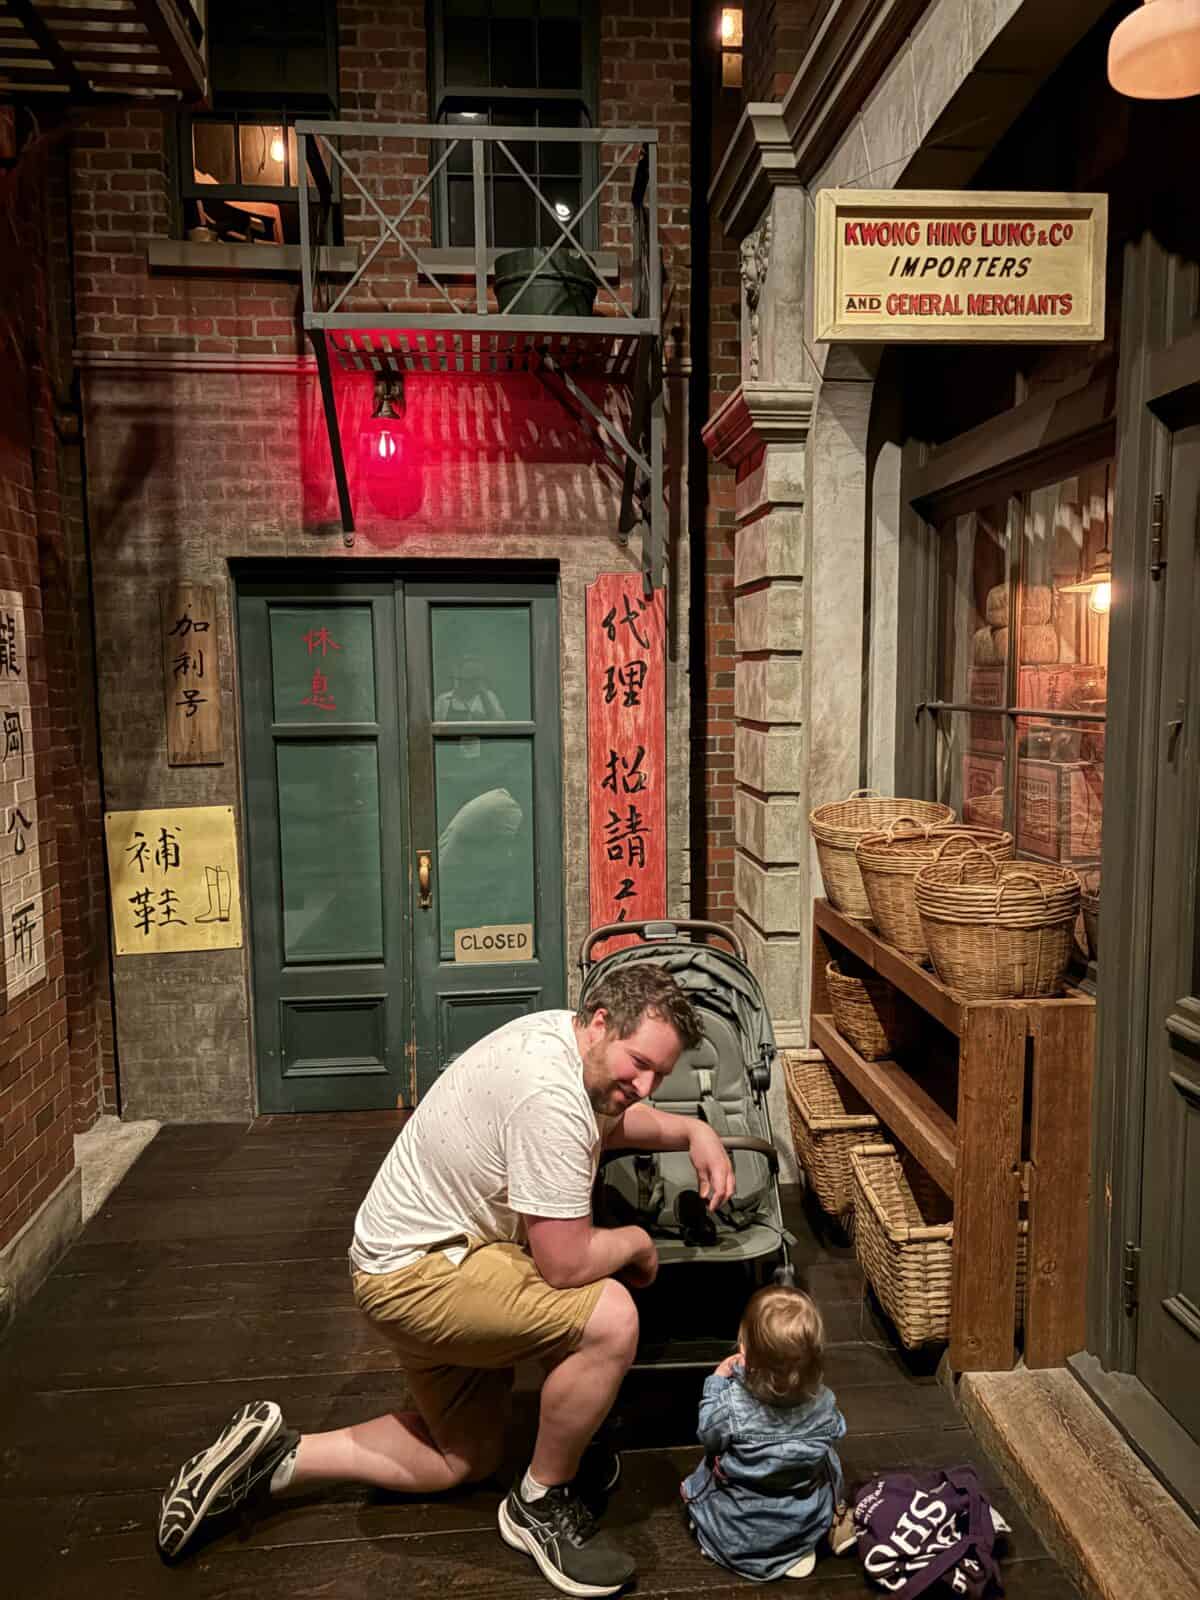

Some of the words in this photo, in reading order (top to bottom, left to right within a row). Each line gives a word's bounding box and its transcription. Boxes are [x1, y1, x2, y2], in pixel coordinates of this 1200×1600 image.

[844, 221, 920, 247] KWONG
[927, 221, 977, 247] HING
[981, 221, 1036, 247] LUNG
[889, 256, 1032, 278] IMPORTERS
[845, 298, 881, 311] AND
[886, 293, 963, 316] GENERAL
[967, 293, 1073, 316] MERCHANTS
[299, 626, 342, 711] 休息
[461, 933, 527, 951] CLOSED
